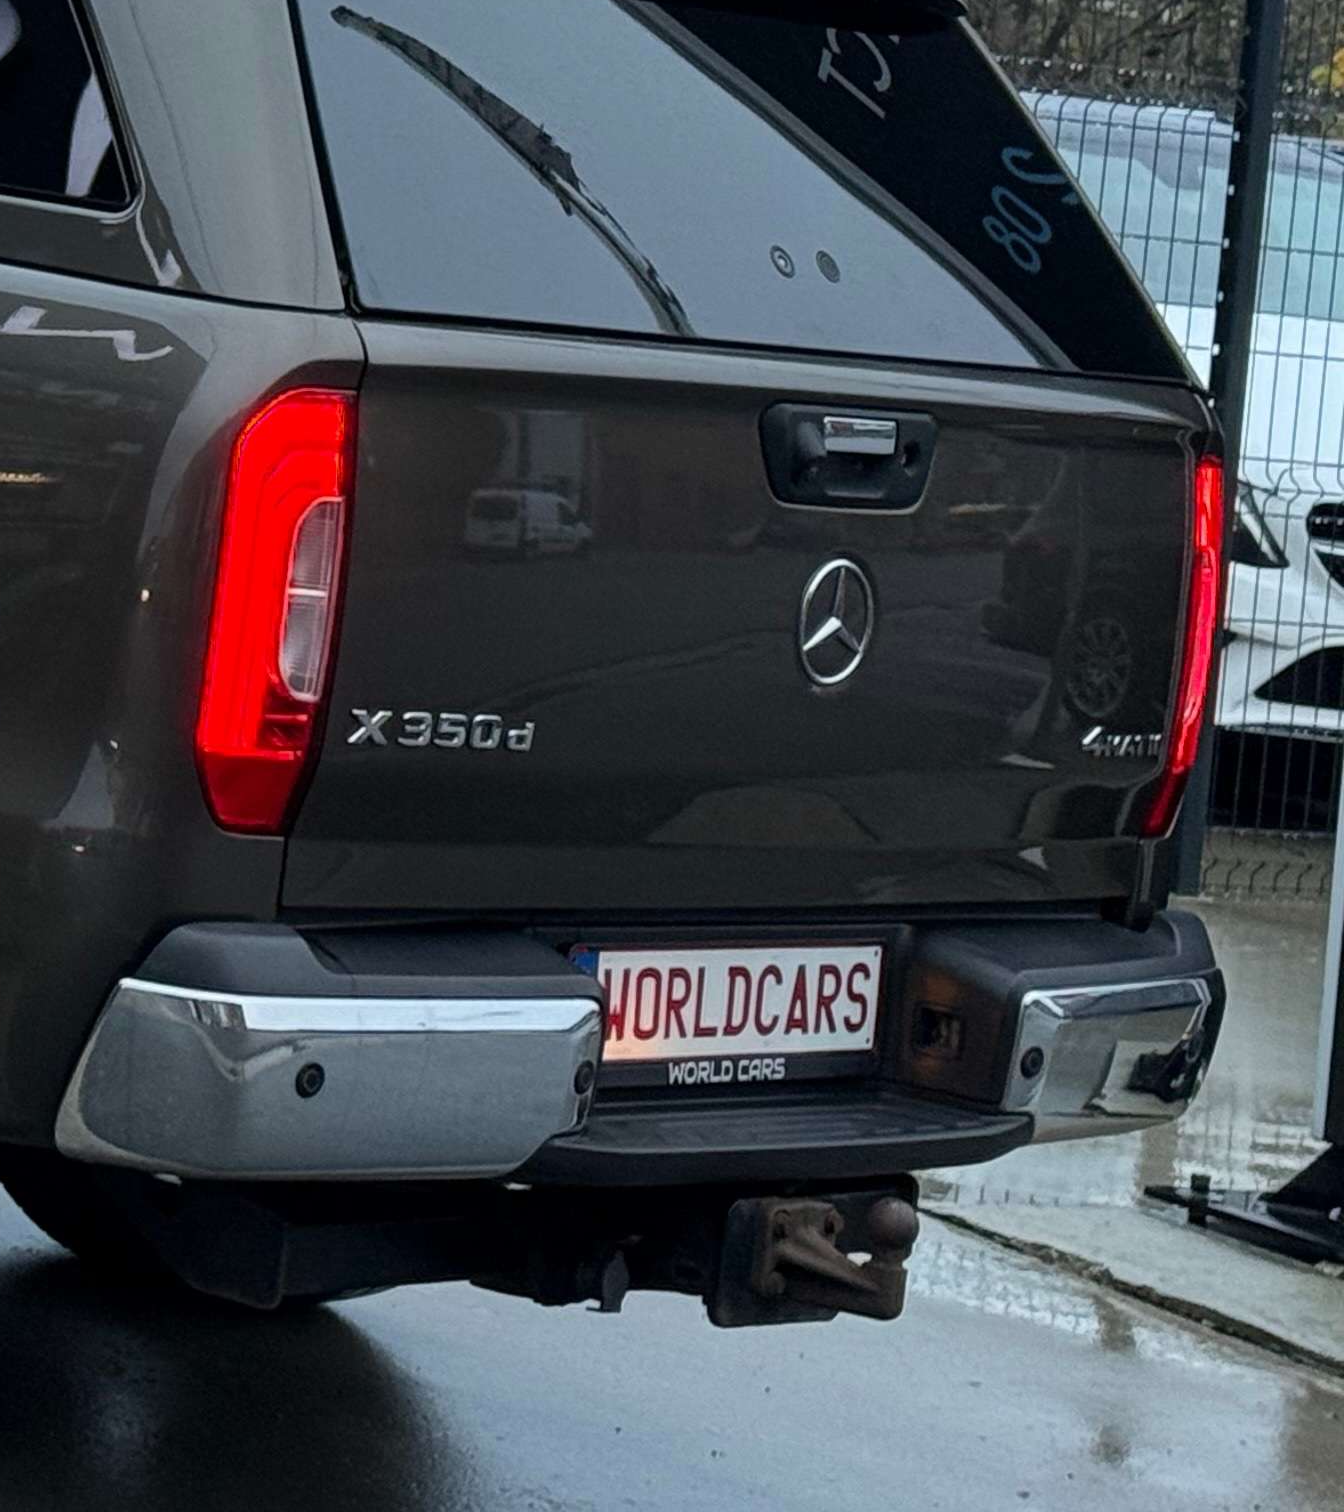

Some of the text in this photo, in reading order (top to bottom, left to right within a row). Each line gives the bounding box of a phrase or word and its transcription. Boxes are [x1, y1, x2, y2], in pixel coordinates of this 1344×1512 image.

[603, 962, 871, 1042] WORLDCARS
[668, 1058, 786, 1085] WORLD CARS
